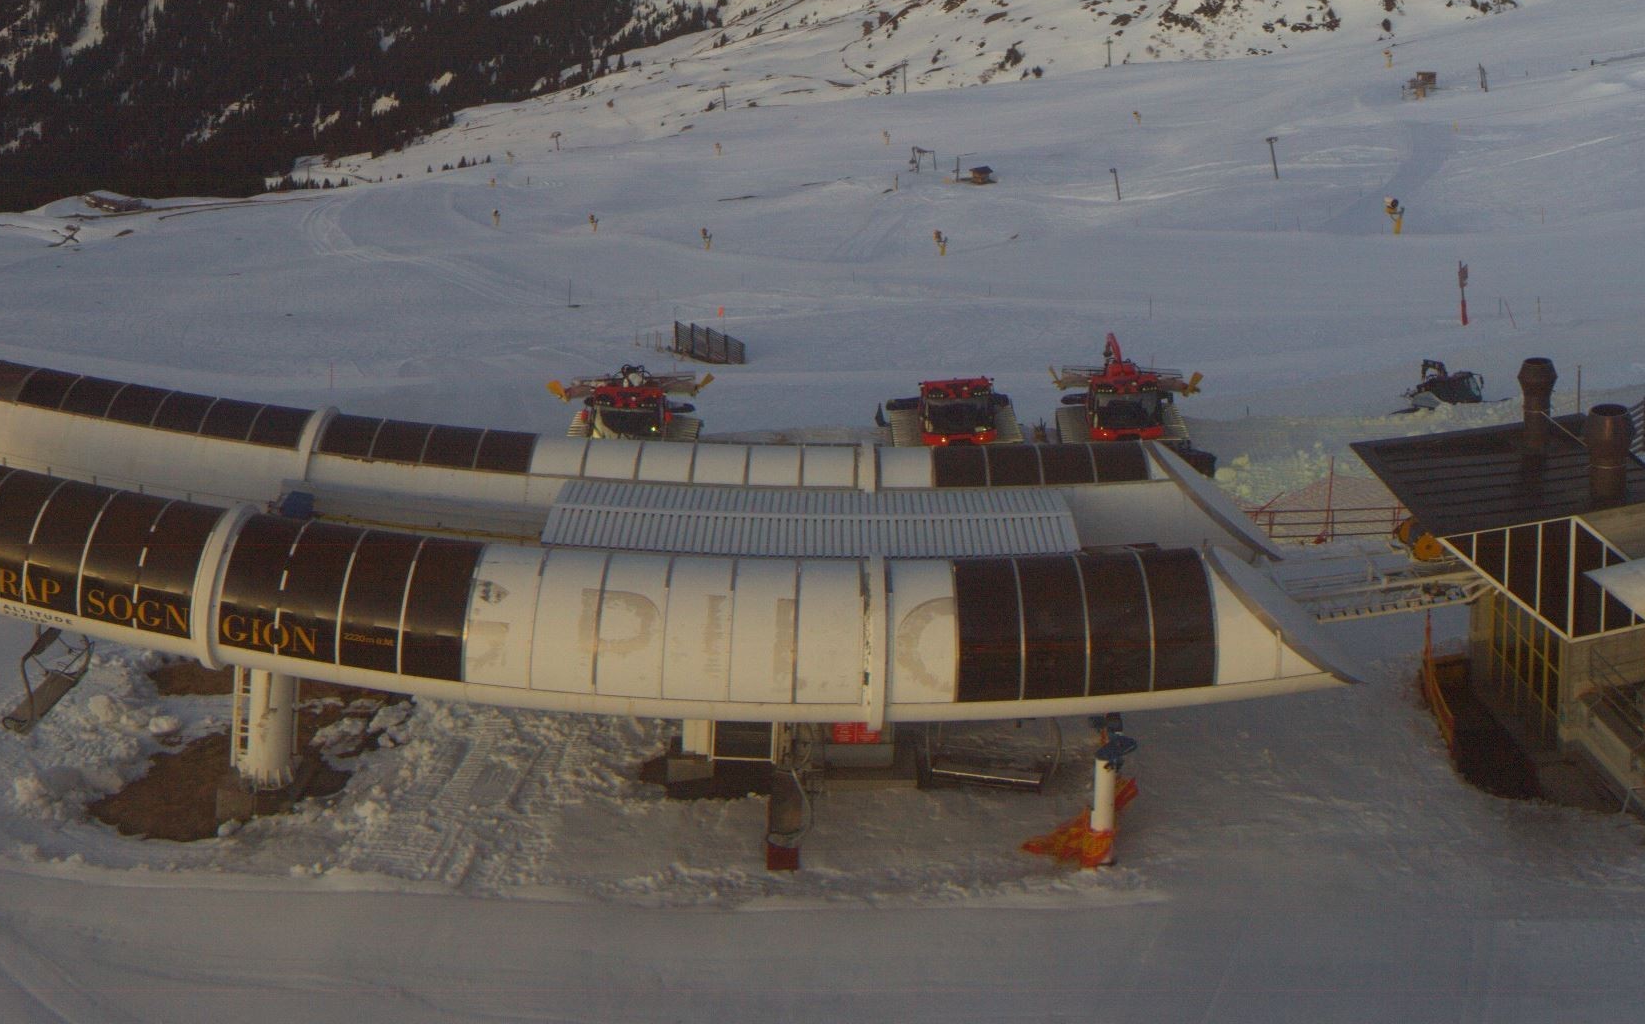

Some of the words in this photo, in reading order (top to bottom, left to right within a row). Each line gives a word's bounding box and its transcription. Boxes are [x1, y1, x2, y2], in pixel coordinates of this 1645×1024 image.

[3, 603, 73, 625] ALTITUDE
[87, 589, 189, 633] SOGN
[222, 614, 318, 655] GION
